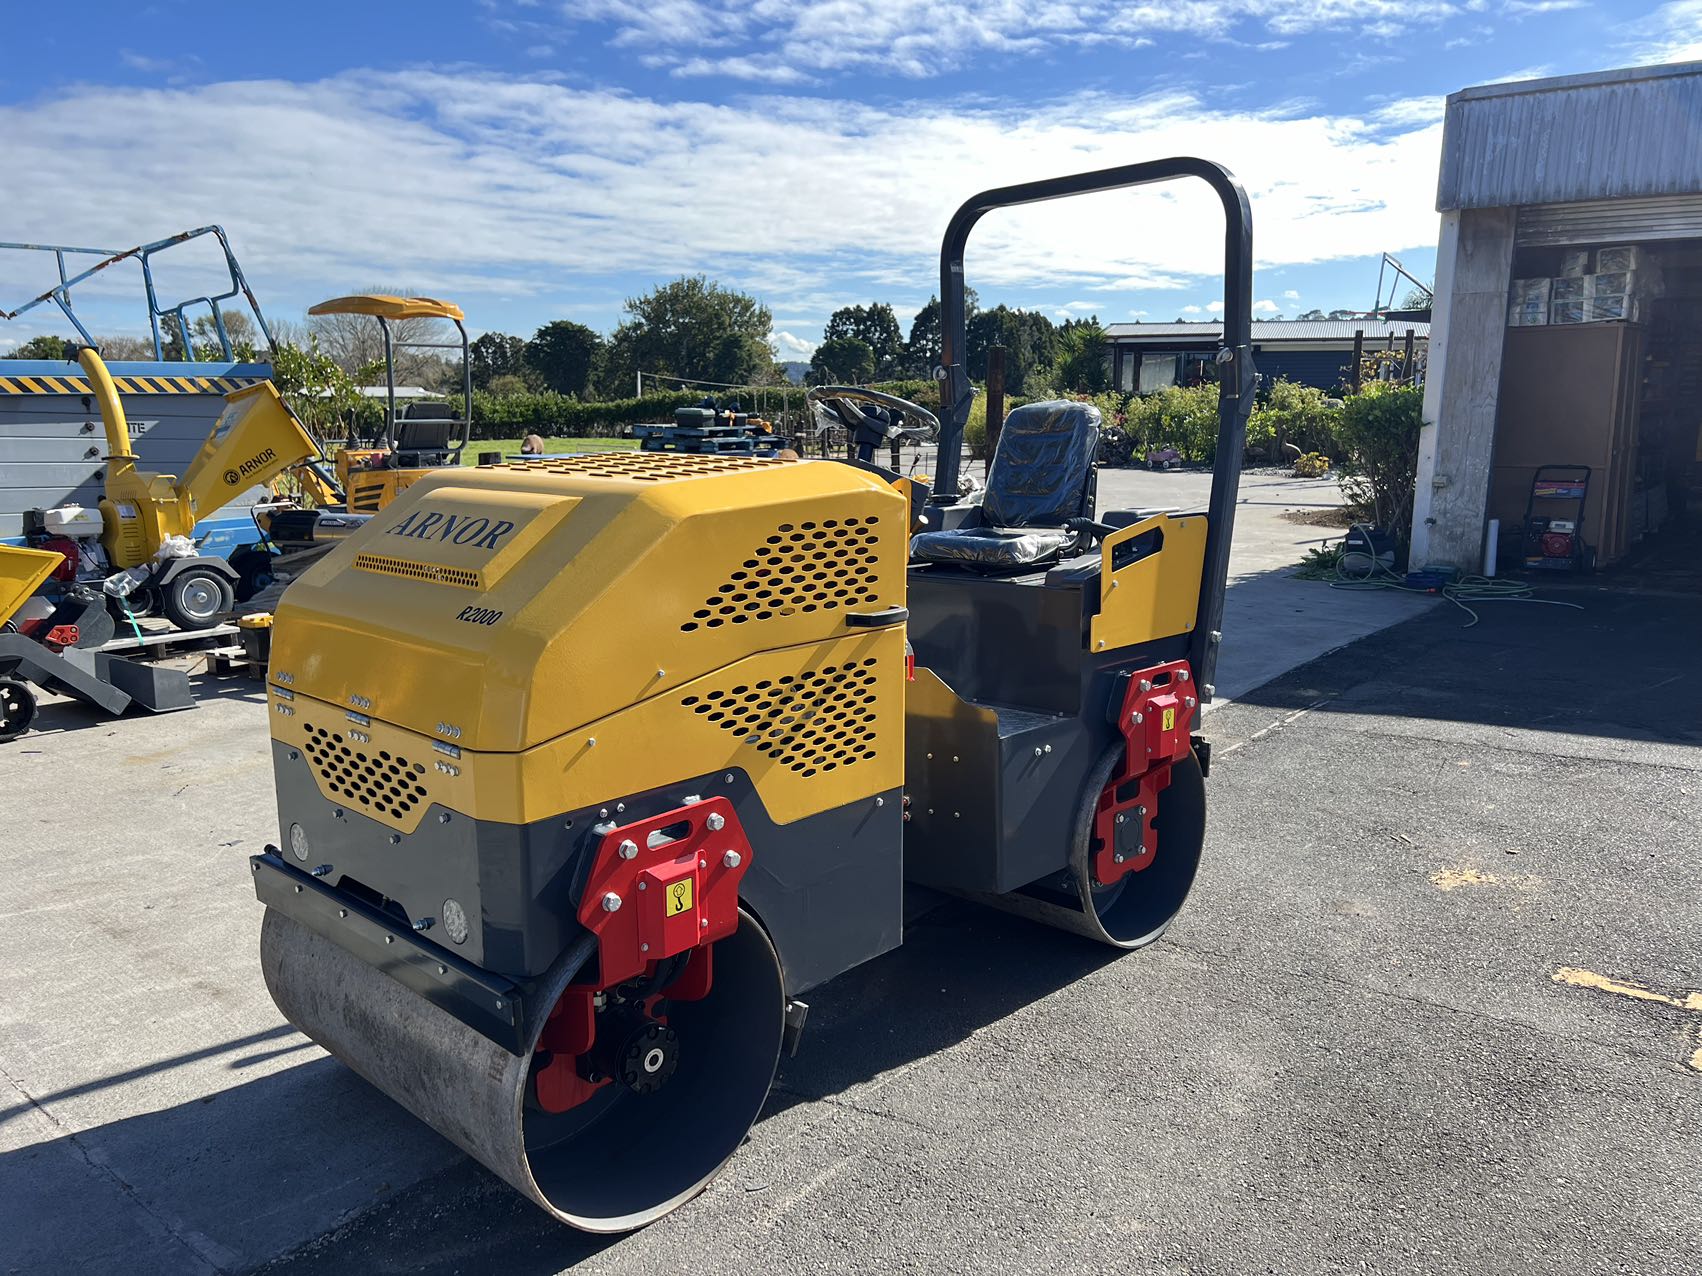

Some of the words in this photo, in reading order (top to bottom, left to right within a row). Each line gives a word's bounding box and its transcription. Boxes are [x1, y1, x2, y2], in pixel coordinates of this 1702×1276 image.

[239, 448, 277, 477] ARNOR
[385, 510, 515, 550] ARNOR
[455, 605, 504, 626] R2000
